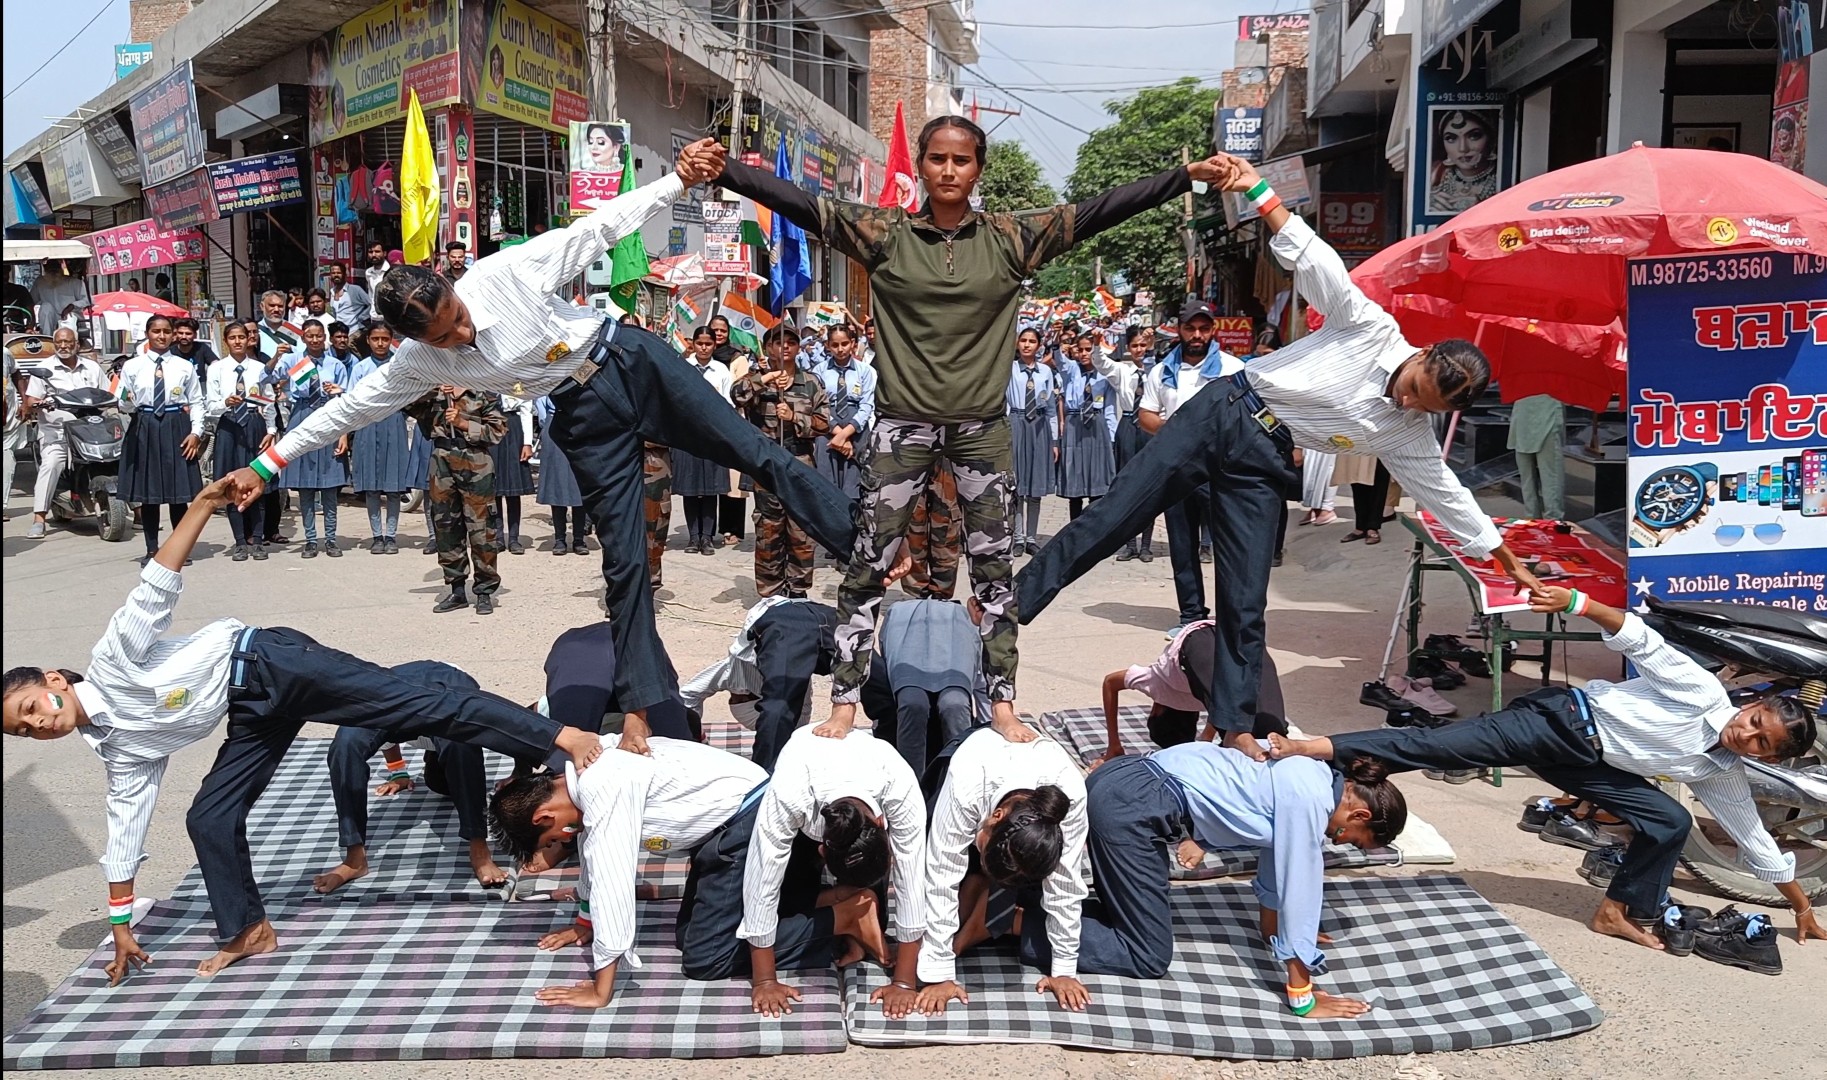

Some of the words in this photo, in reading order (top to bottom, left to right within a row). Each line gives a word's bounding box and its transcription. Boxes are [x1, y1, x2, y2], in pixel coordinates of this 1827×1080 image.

[339, 33, 363, 67] Guru
[365, 5, 402, 55] Nanak
[499, 2, 525, 47] Guru
[527, 16, 556, 60] Nanak
[355, 50, 401, 91] Cosmetics
[515, 50, 554, 90] Cosmetics
[1225, 117, 1262, 134] ਜਨਤਾ
[214, 175, 233, 190] Arsh
[233, 170, 260, 187] Mobile
[260, 166, 298, 182] Repairing
[1325, 202, 1375, 225] 99
[1328, 225, 1369, 234] Corner
[1530, 228, 1553, 238] Data
[1555, 225, 1590, 236] delight
[1631, 256, 1772, 286] M.98725-33560
[1667, 574, 1730, 594] Mobile
[1735, 571, 1826, 593] Repairing
